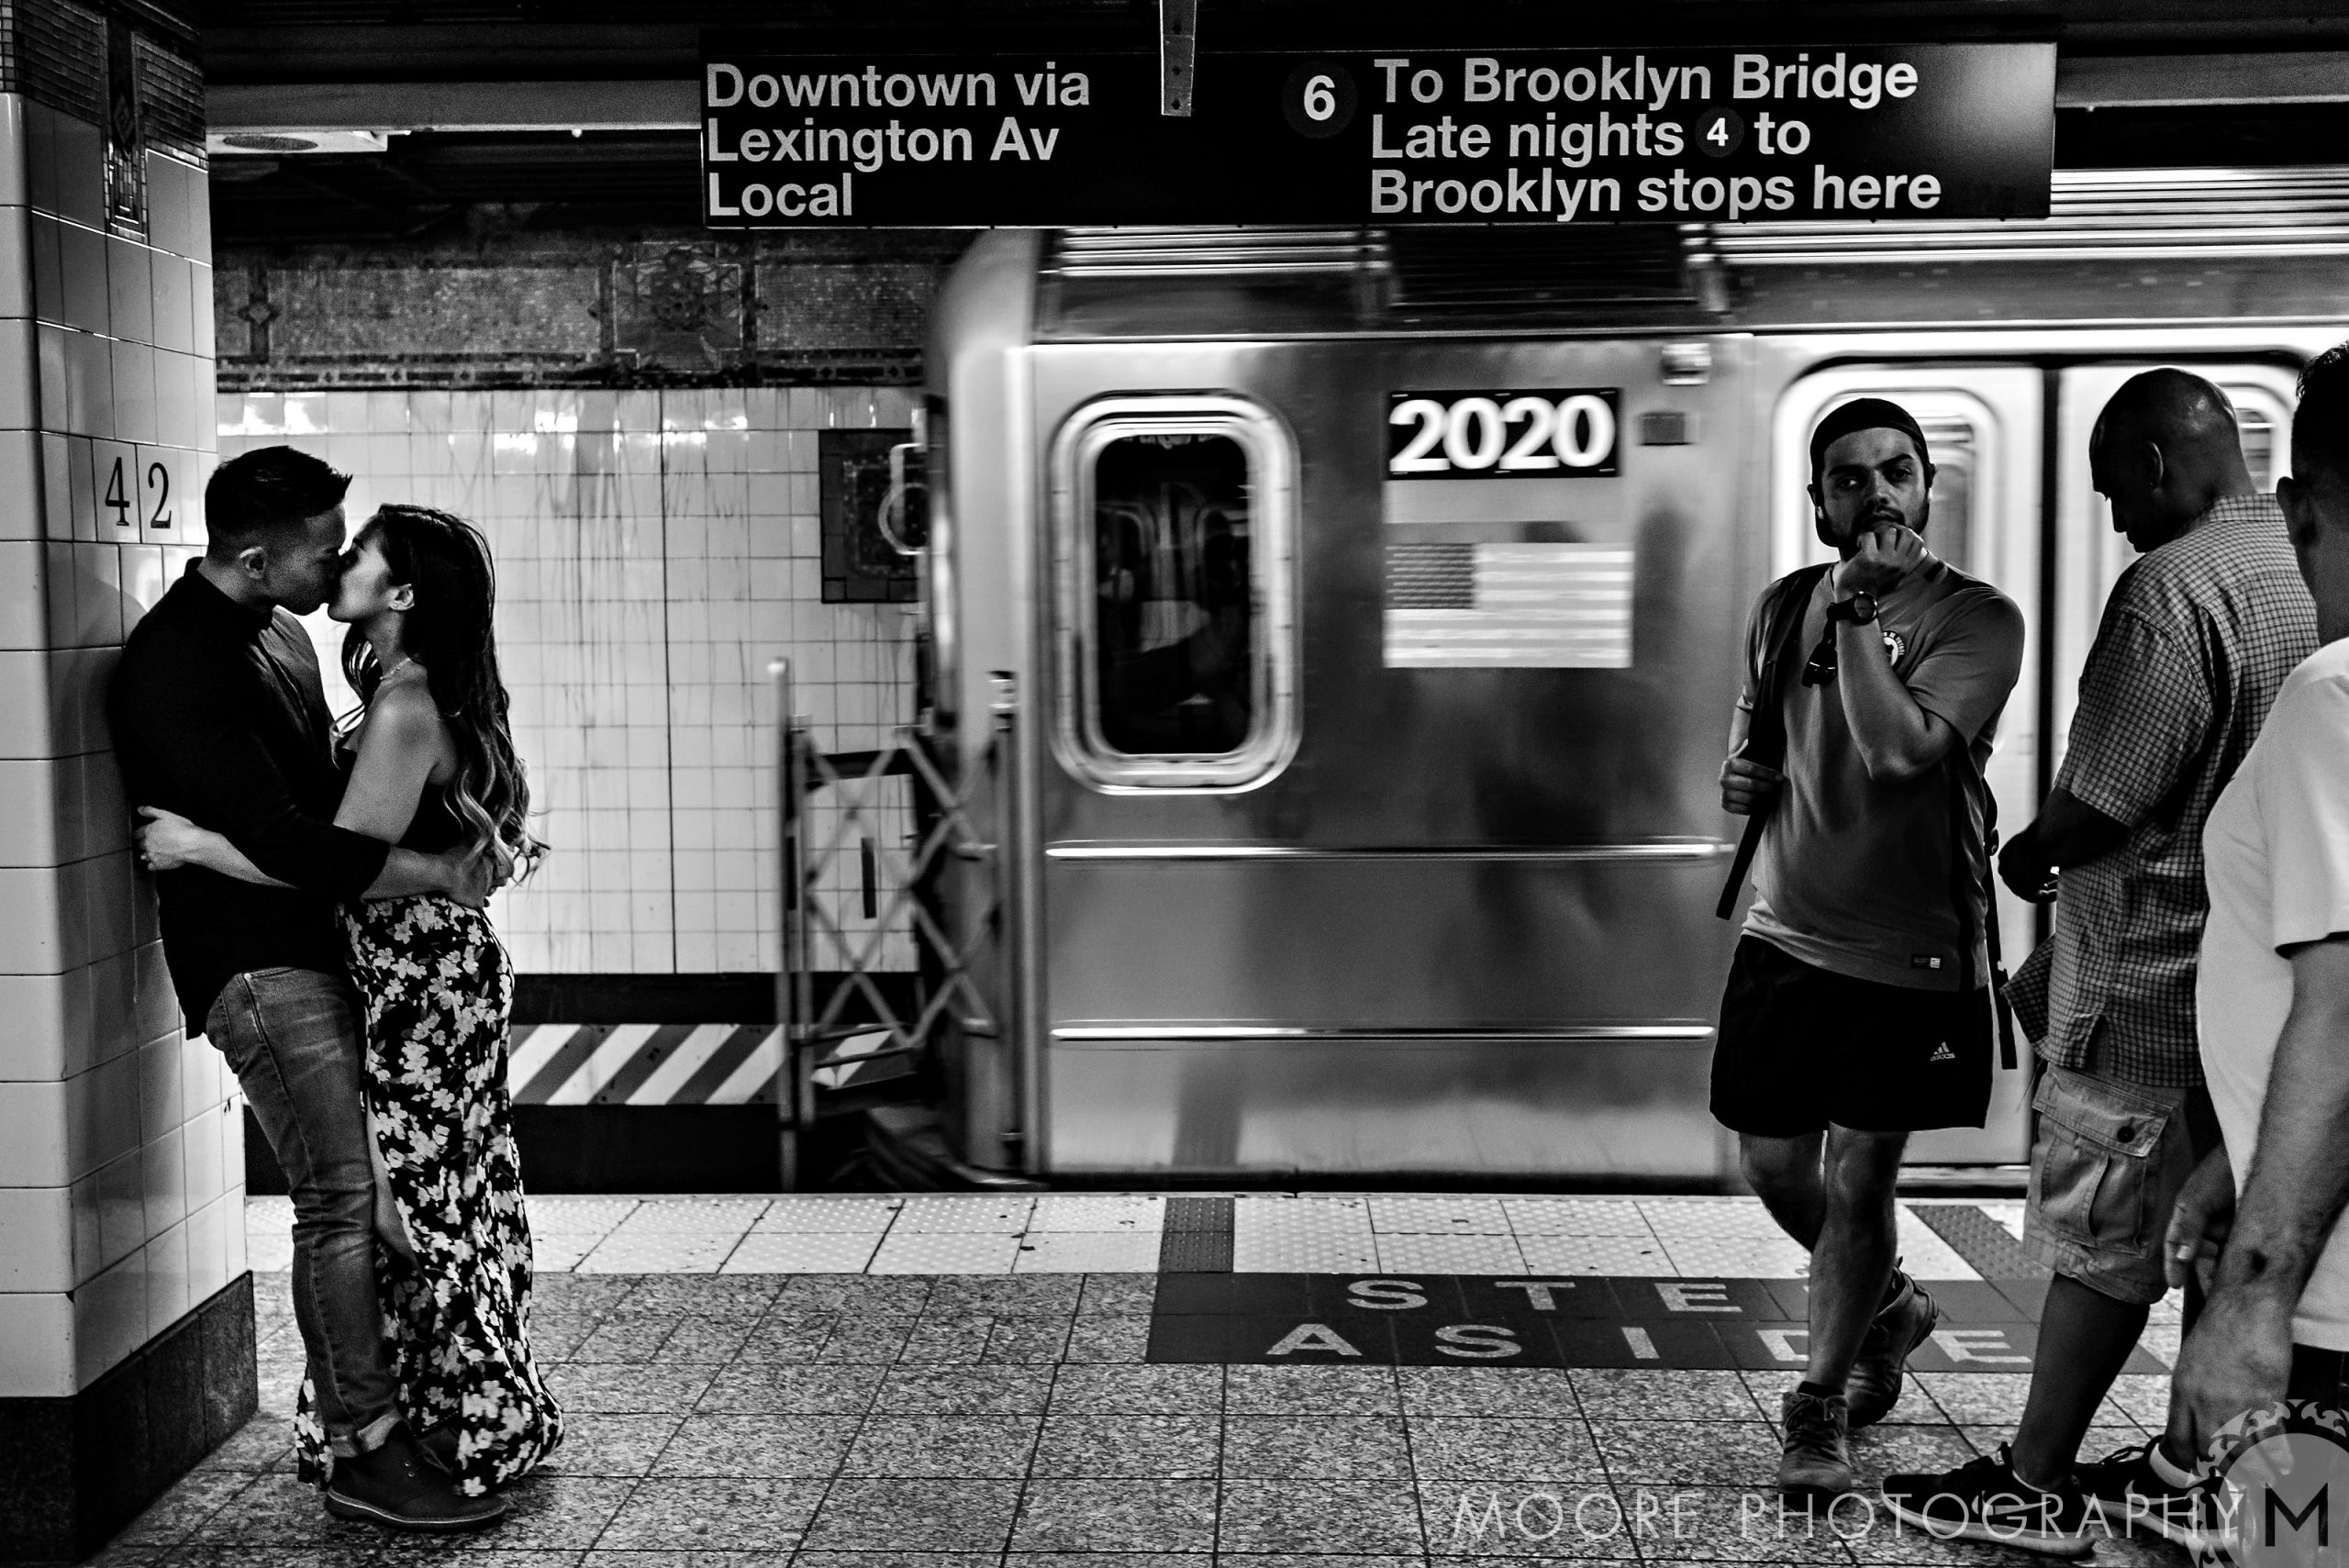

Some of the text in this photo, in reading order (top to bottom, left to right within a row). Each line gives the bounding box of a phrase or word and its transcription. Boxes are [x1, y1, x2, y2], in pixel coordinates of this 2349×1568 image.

[707, 61, 1090, 108] Downtown via
[1303, 74, 1336, 121] 6
[1374, 52, 1919, 111] To Brooklyn Bridge
[707, 117, 1060, 172] Lexington Av
[1372, 111, 1811, 168] Late nights 4 to
[708, 172, 852, 217] Local
[1371, 163, 1942, 223] Brooklyn stops here
[1388, 394, 1617, 473] 2020
[105, 456, 172, 528] 42
[1346, 1279, 1809, 1310] STE
